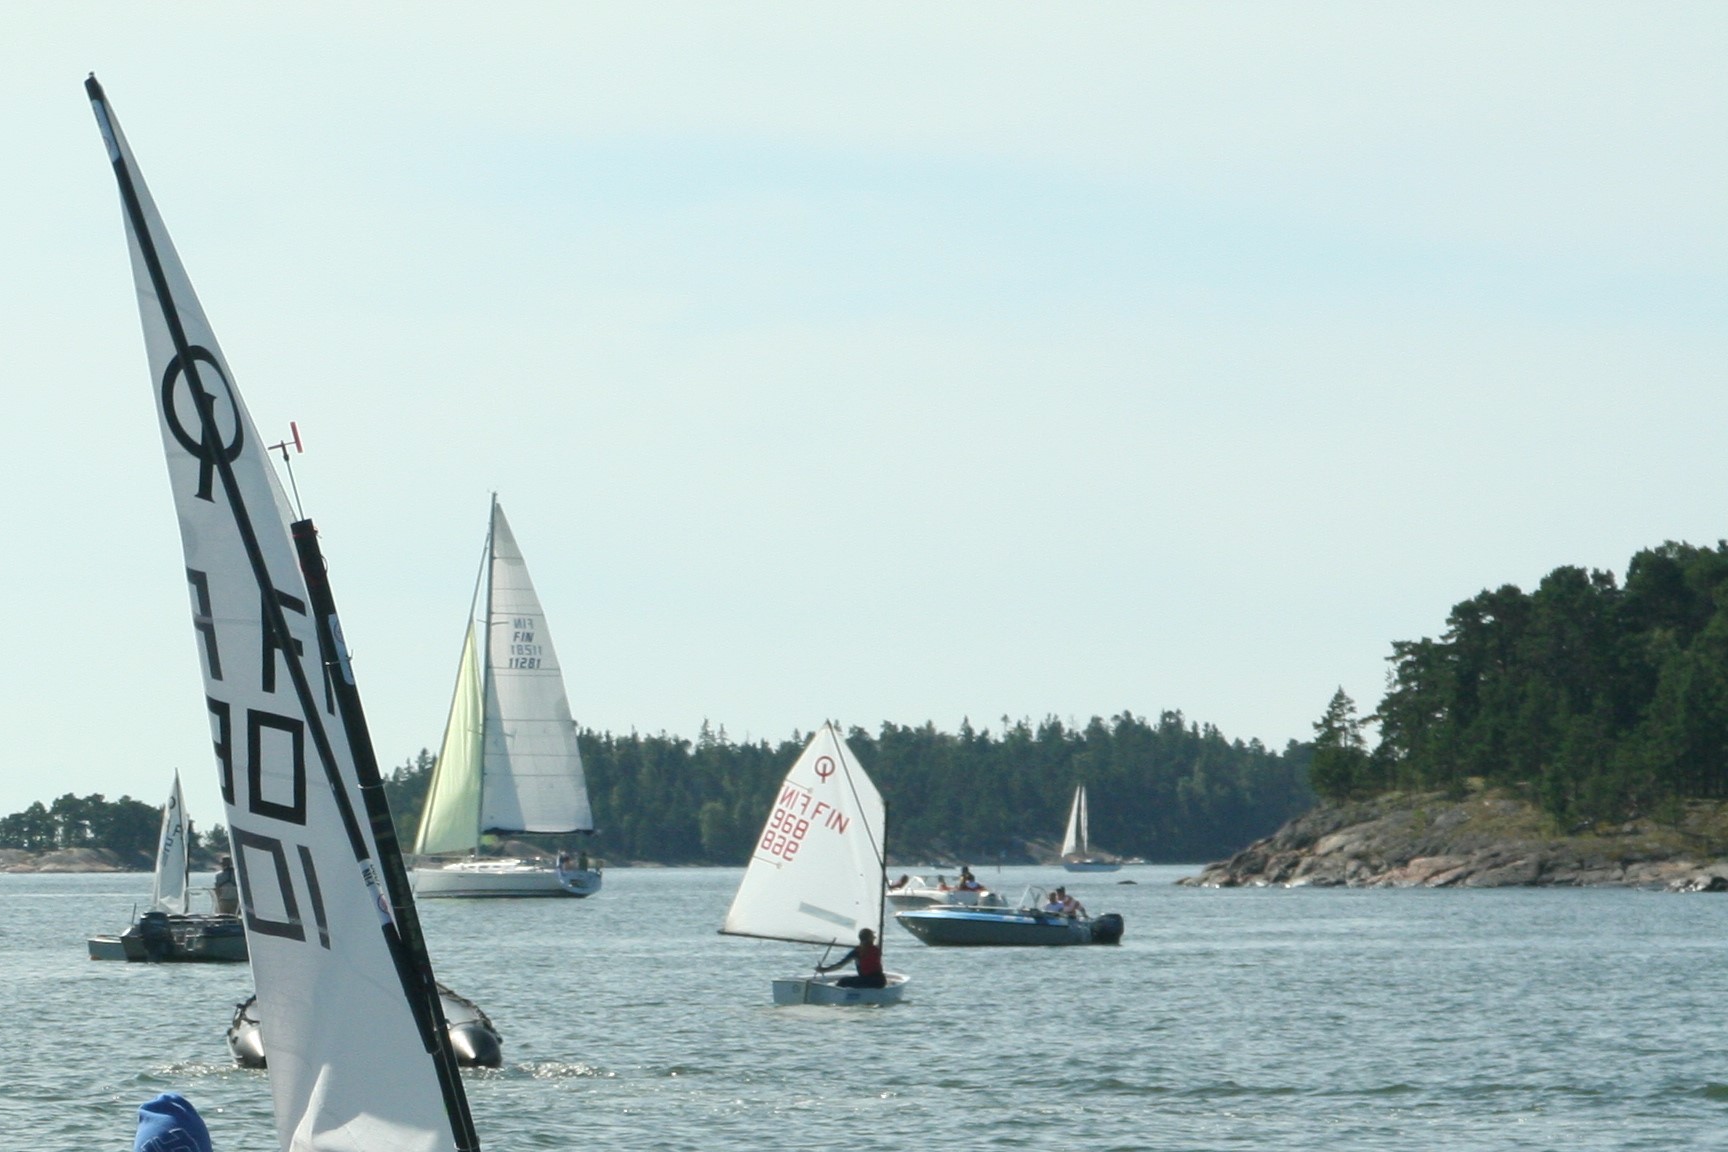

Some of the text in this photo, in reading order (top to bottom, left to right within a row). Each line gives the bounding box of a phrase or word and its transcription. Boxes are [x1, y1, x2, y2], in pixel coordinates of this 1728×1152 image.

[513, 631, 535, 642] FIN
[508, 657, 541, 669] 11281
[770, 808, 810, 840] 968
[811, 801, 850, 835] FIN
